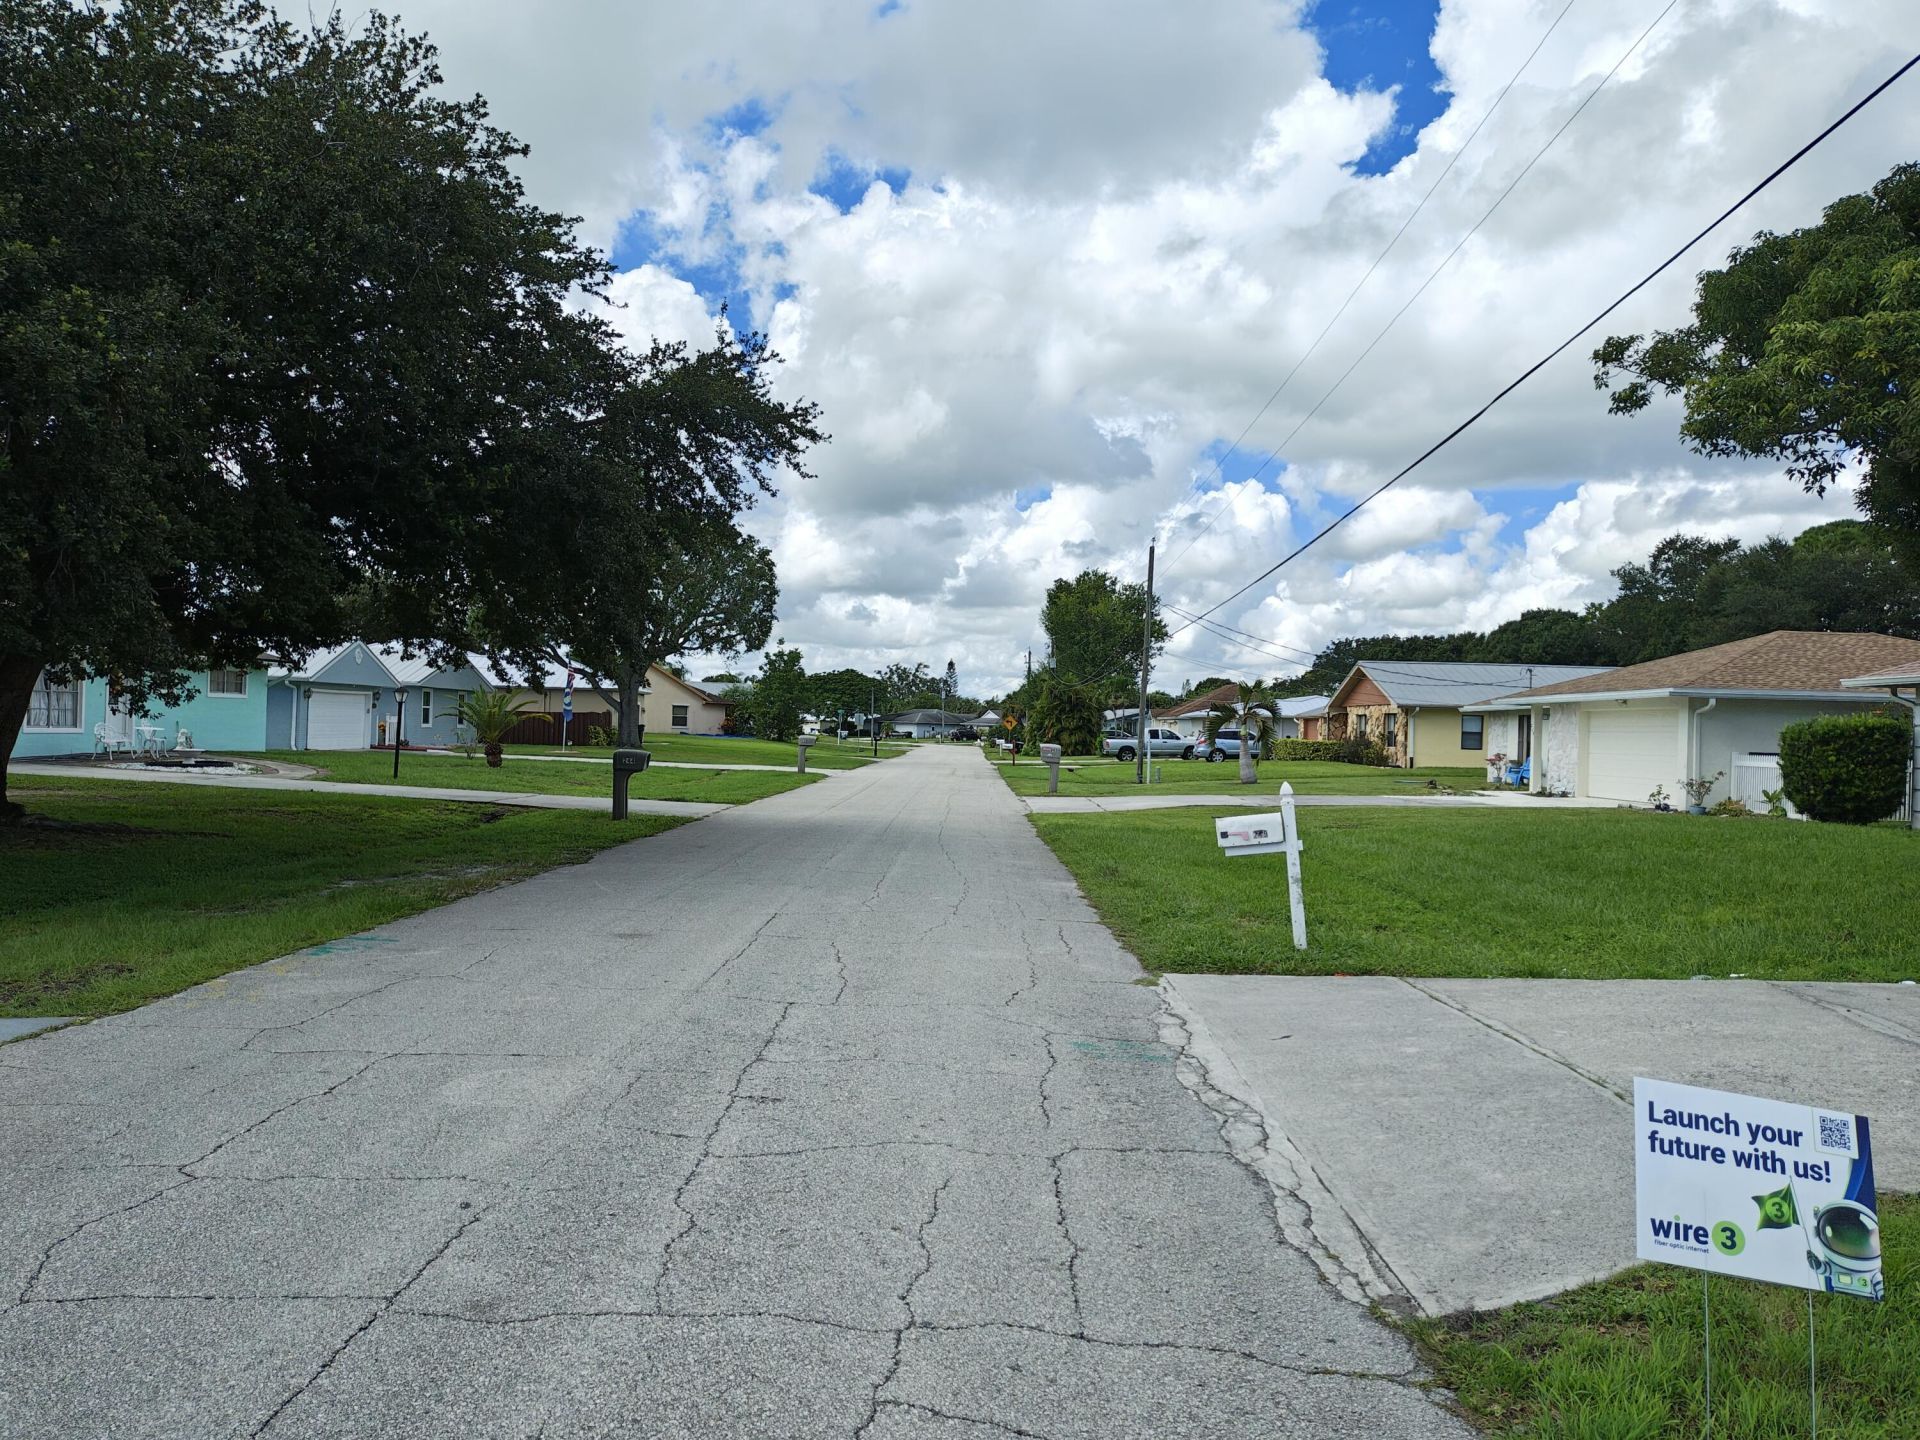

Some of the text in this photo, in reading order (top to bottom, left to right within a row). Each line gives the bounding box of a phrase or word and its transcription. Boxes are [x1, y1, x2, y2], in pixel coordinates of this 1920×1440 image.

[1648, 1100, 1803, 1147] Launch your
[1648, 1130, 1831, 1183] future with us!
[1771, 1200, 1785, 1220] 3
[1650, 1214, 1737, 1250] wire 3
[1654, 1239, 1709, 1254] fiber optic internet
